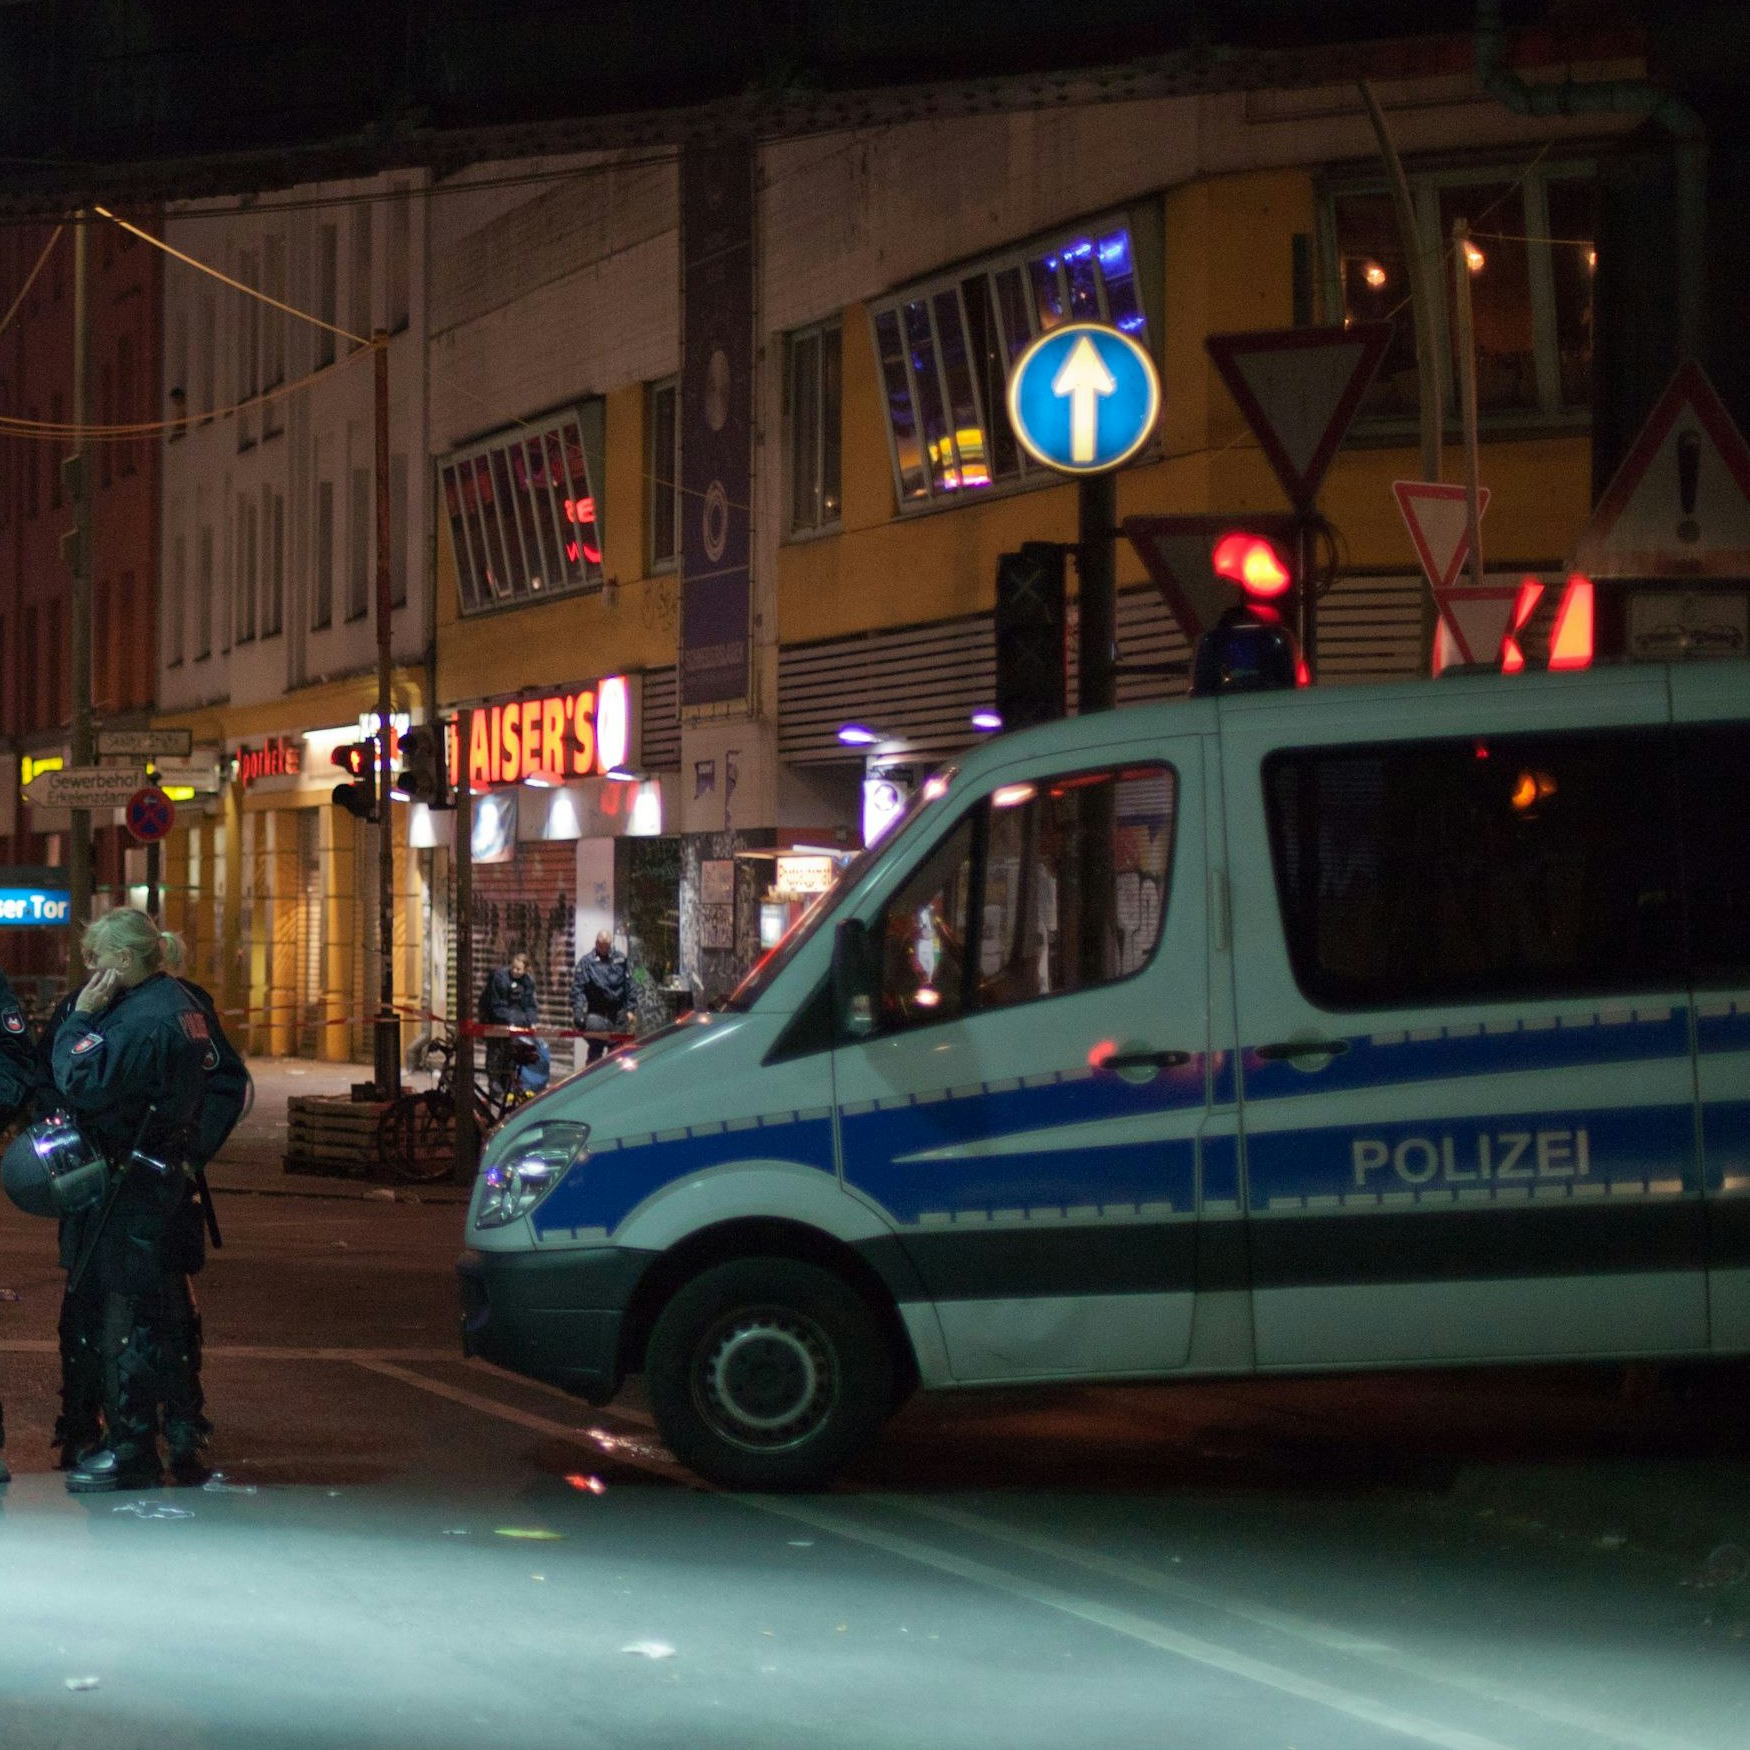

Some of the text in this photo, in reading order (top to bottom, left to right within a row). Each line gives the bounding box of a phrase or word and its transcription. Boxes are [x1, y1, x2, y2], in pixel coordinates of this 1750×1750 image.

[49, 771, 140, 790] Gewerbehof
[30, 894, 67, 919] Tor
[1352, 1128, 1590, 1186] POLIZEI
